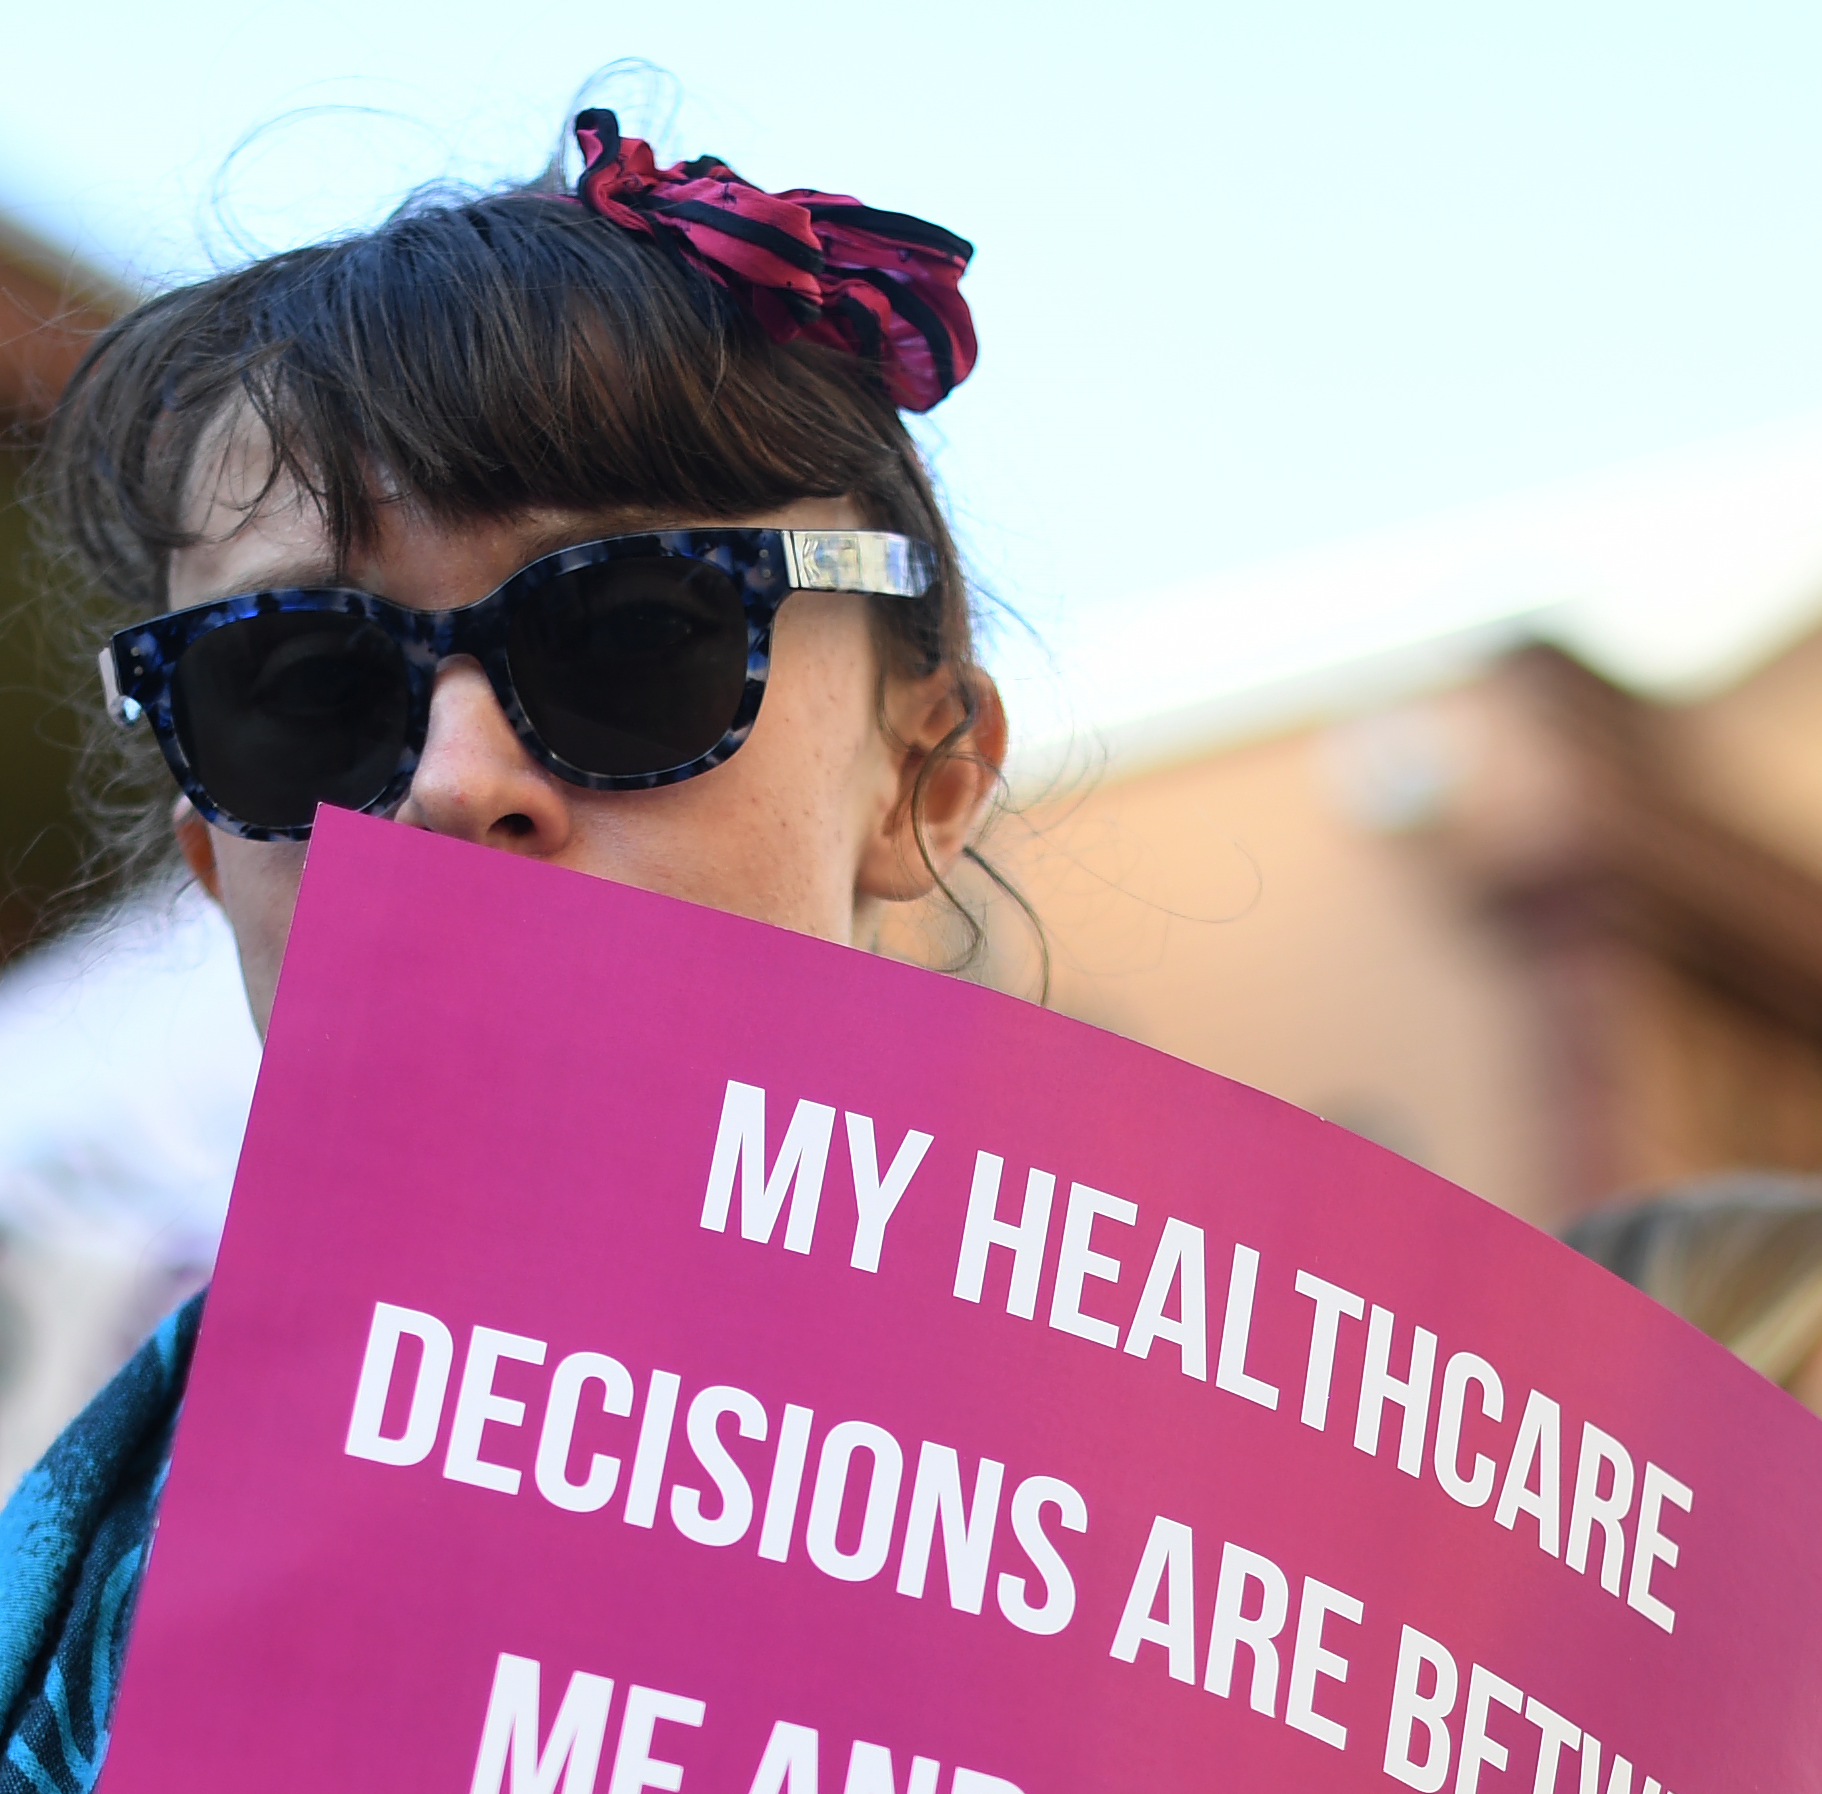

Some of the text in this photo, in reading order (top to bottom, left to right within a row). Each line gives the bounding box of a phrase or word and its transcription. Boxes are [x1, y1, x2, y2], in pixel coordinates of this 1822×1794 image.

[345, 1301, 1088, 1635] DECISIONS
[1109, 1515, 1364, 1750] ARE
[700, 1080, 1694, 1634] MY HEALTHCARE
